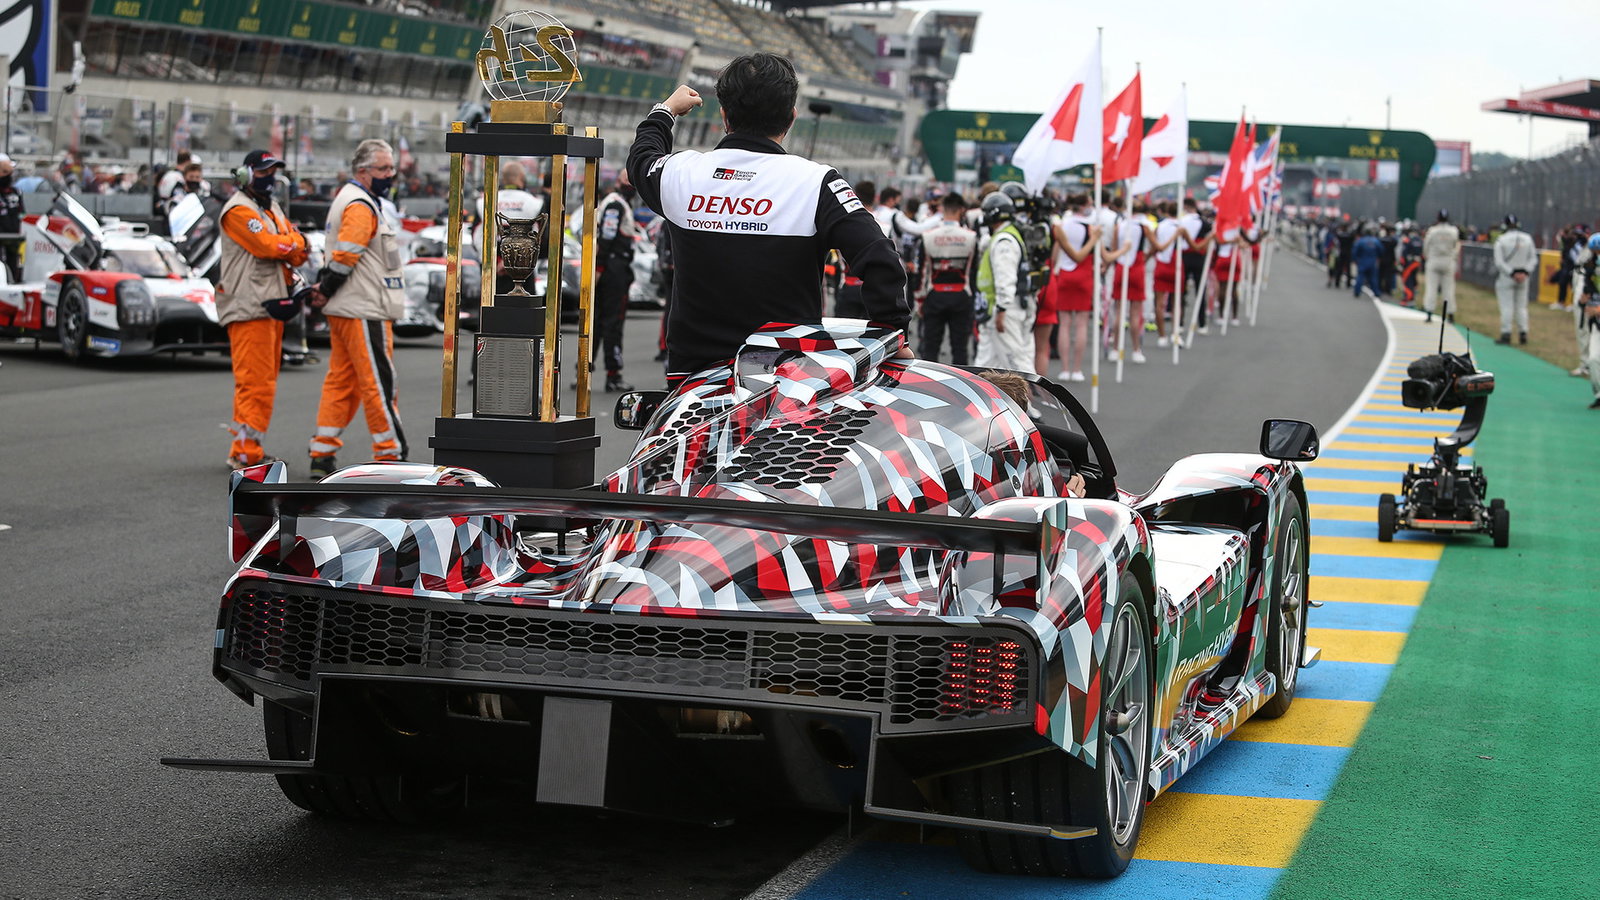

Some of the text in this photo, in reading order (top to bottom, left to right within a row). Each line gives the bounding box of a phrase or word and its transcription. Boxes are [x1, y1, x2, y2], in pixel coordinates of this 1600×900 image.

[956, 128, 1007, 141] ROLEX
[1349, 145, 1399, 159] ROLEX
[687, 194, 773, 216] DENSO
[687, 219, 768, 232] TOYOTA HYBRID
[1172, 642, 1214, 686] RACING
